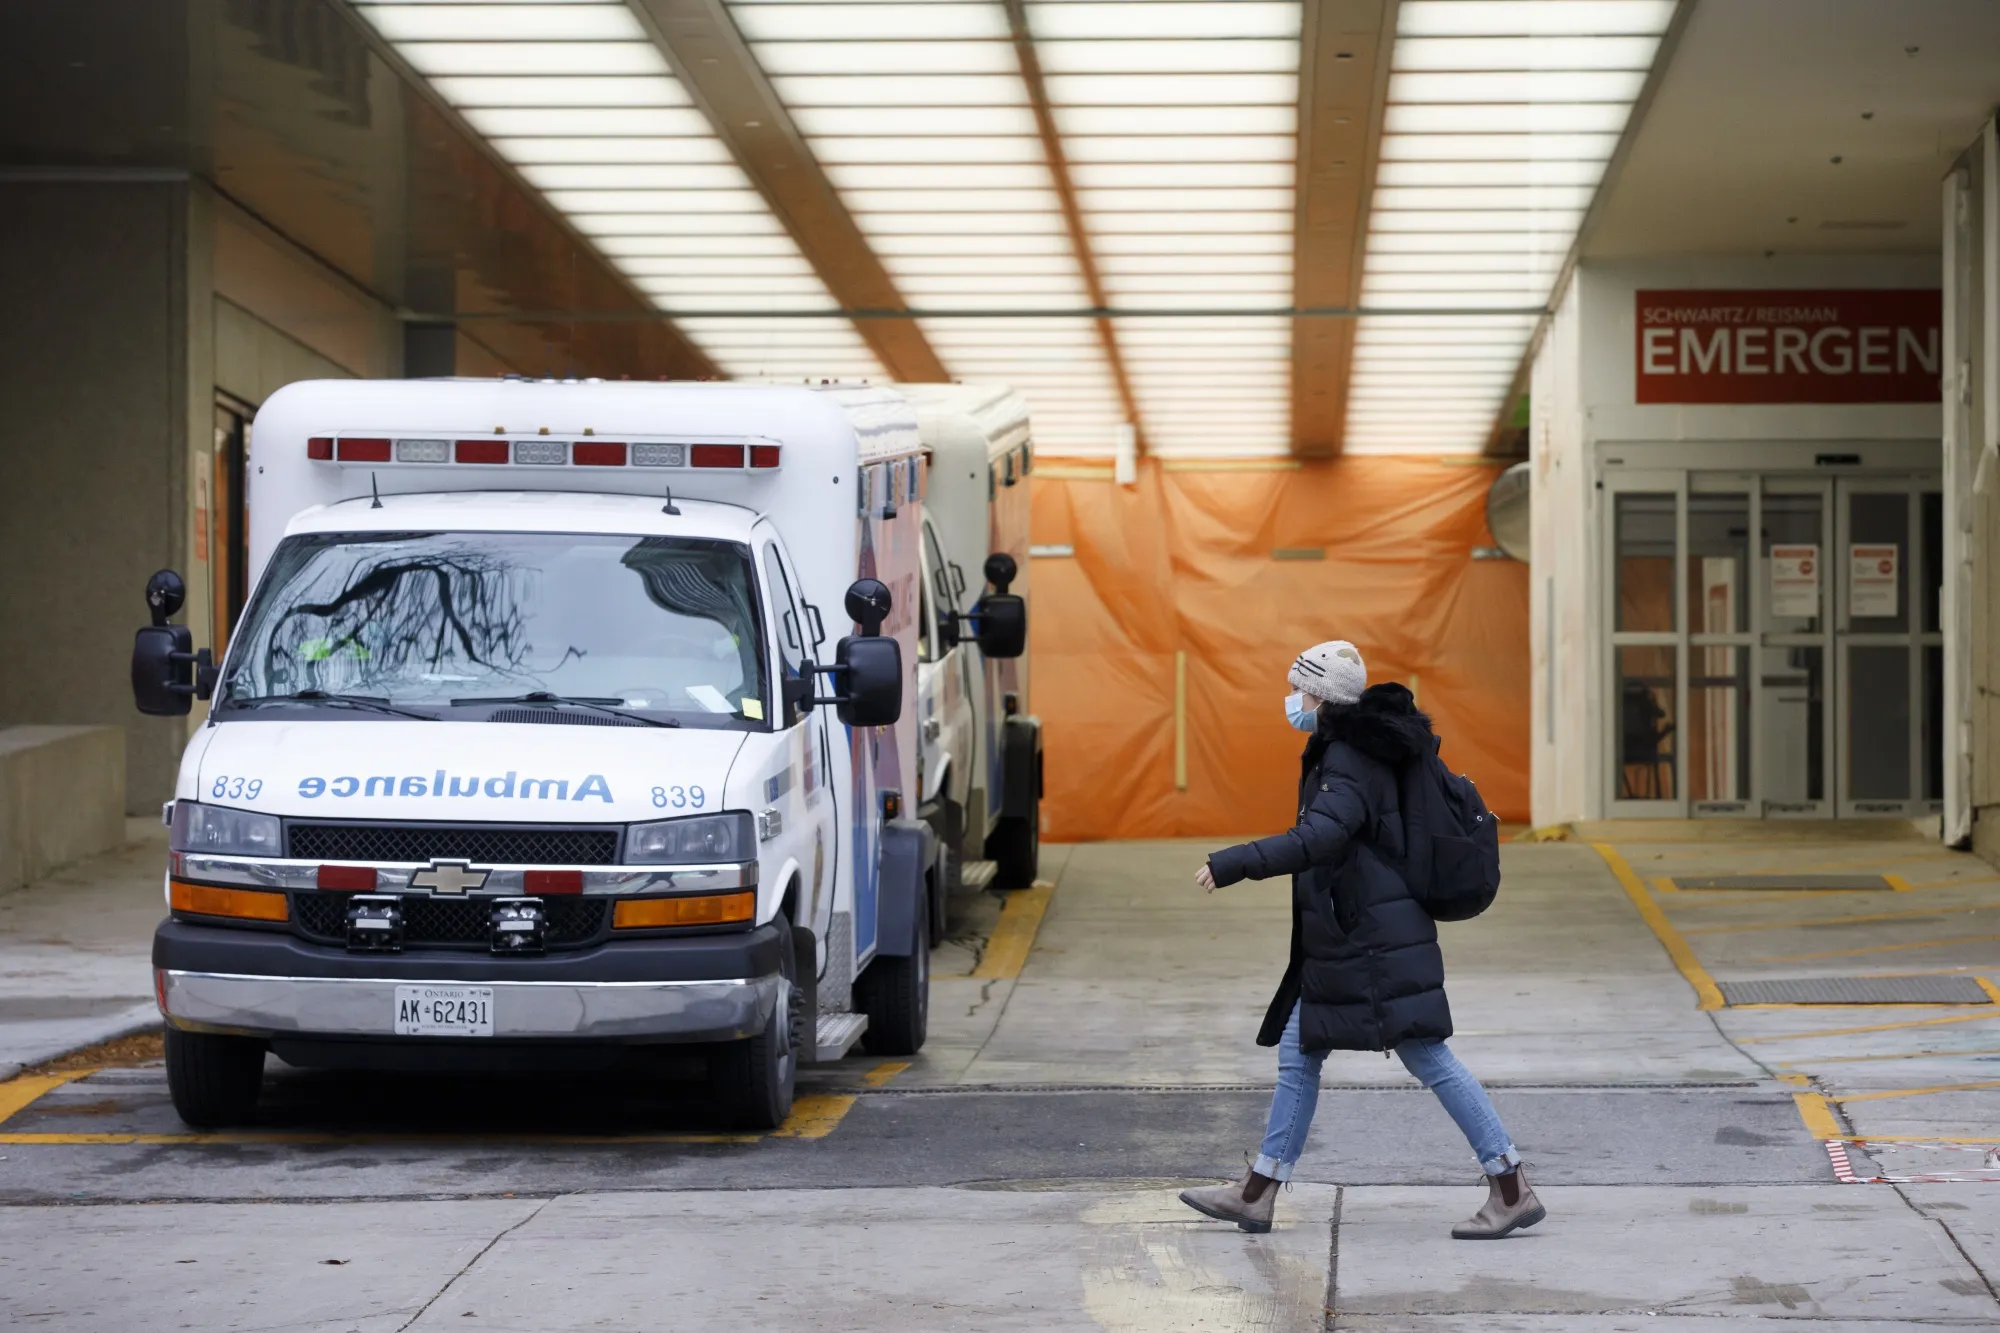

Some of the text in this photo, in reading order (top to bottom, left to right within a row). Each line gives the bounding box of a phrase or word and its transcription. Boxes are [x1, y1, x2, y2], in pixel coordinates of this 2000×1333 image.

[1643, 327, 1939, 375] EMERGEN
[212, 775, 263, 801] 839
[651, 785, 706, 809] 839
[424, 989, 464, 999] ONTARIO
[400, 999, 488, 1025] AK 62431
